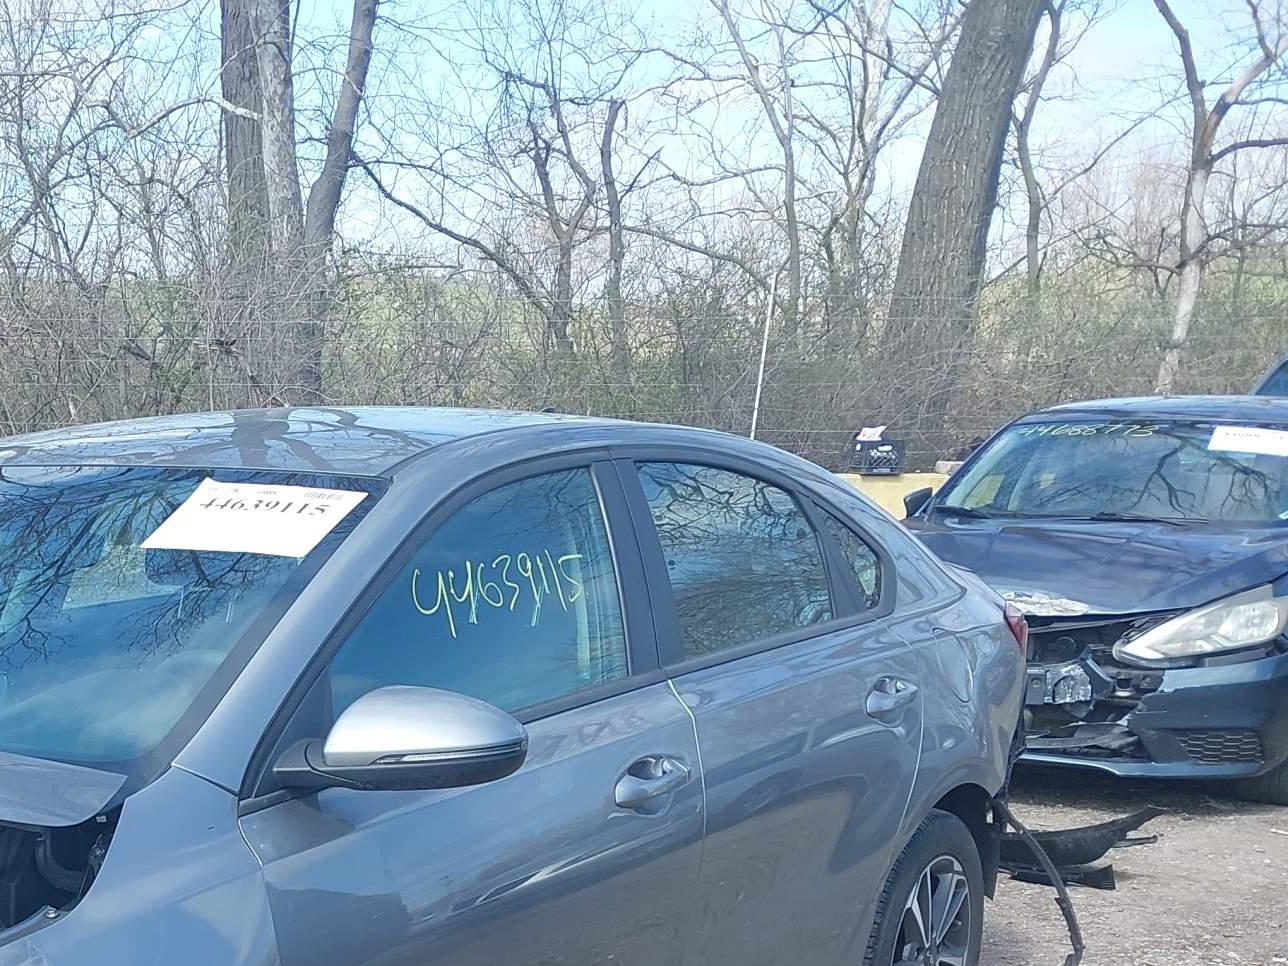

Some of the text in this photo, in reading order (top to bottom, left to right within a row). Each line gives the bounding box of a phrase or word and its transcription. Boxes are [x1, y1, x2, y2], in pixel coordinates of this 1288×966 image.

[1018, 423, 1159, 437] 44688773
[199, 497, 331, 516] 44639115
[411, 549, 584, 639] 44639115
